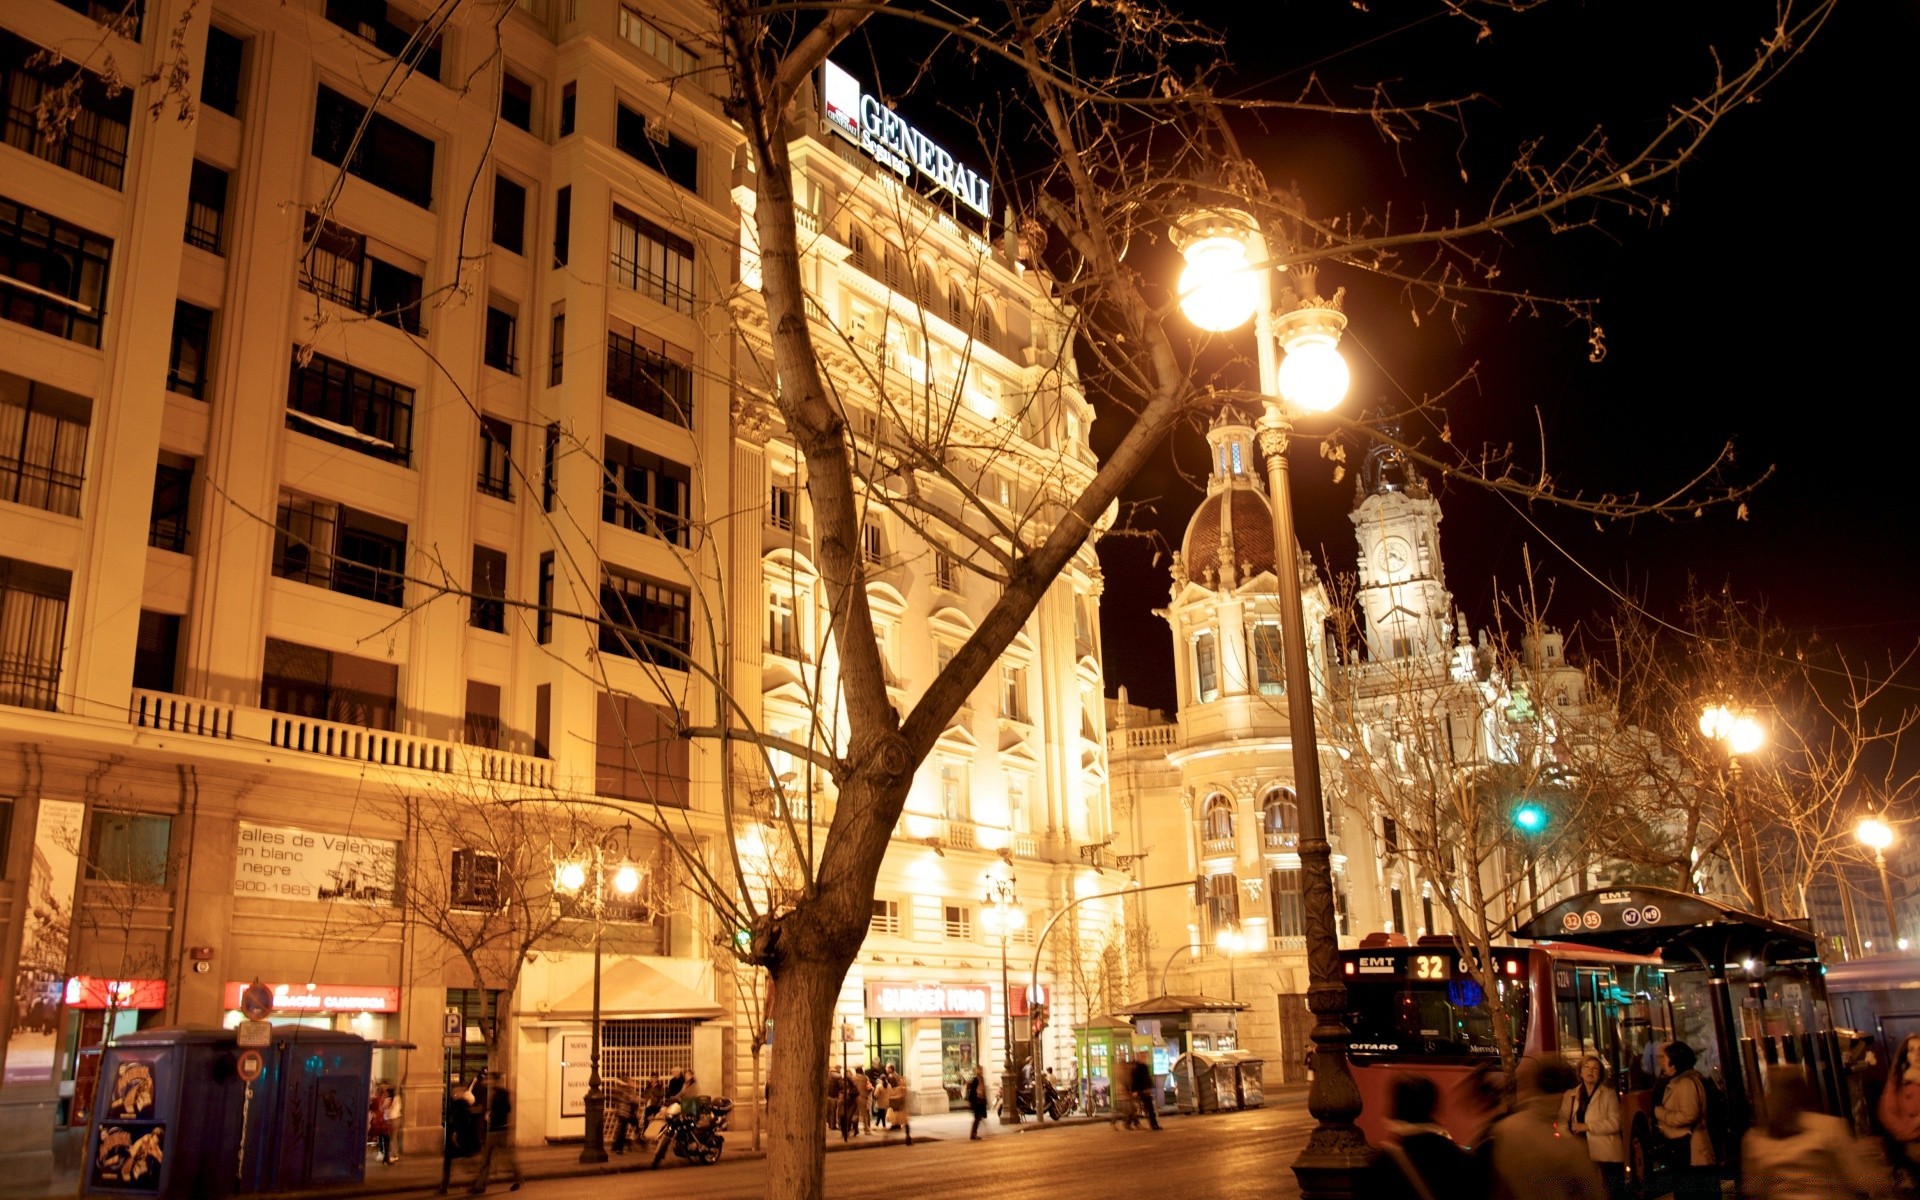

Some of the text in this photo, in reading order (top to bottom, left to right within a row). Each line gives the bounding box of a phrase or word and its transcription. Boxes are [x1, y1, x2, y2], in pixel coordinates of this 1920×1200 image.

[861, 94, 991, 219] GENERALI
[239, 828, 395, 857] alles de València
[261, 846, 303, 862] blanc
[242, 862, 291, 876] negre
[1599, 891, 1631, 899] EMT
[1566, 909, 1657, 926] 32 35 N7 N9
[1359, 957, 1395, 967] EMT
[1416, 955, 1443, 979] 32
[882, 987, 986, 1012] BURGER KING
[447, 1013, 459, 1033] P
[1350, 1043, 1399, 1051] CITARO
